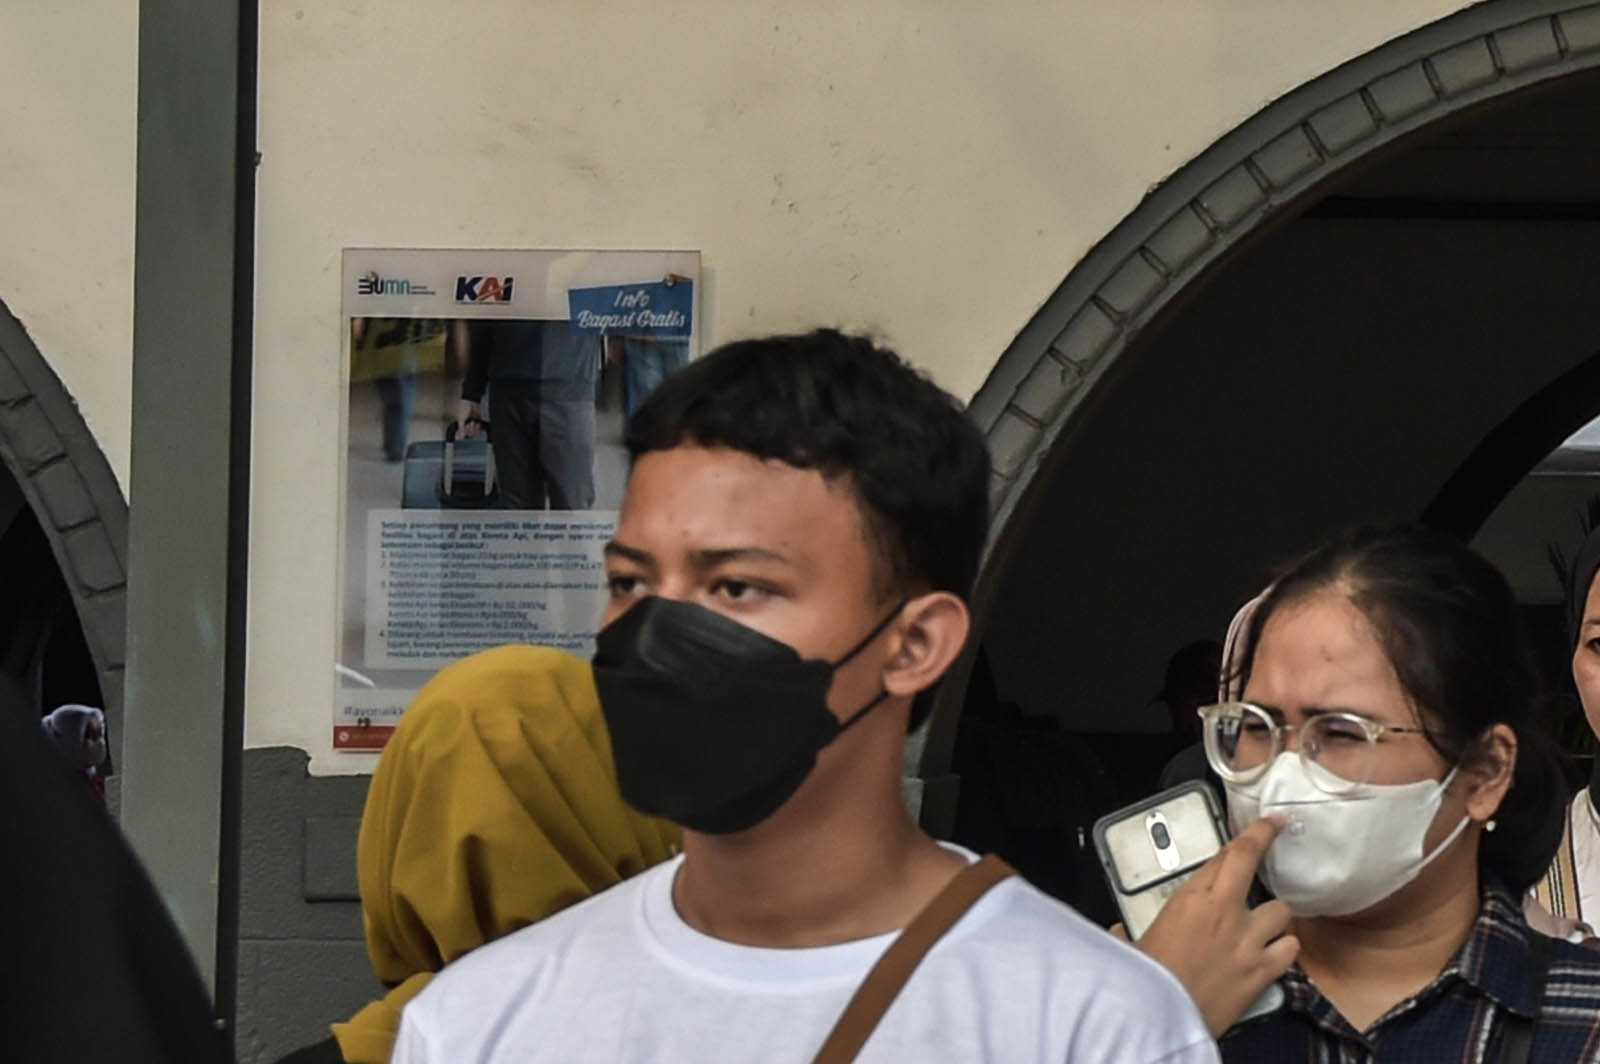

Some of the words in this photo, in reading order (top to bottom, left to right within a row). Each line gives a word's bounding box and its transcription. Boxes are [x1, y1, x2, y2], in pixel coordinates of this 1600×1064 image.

[455, 276, 514, 302] KAI
[614, 289, 649, 309] Info
[577, 310, 634, 334] Bagasi
[636, 310, 686, 329] Gratis
